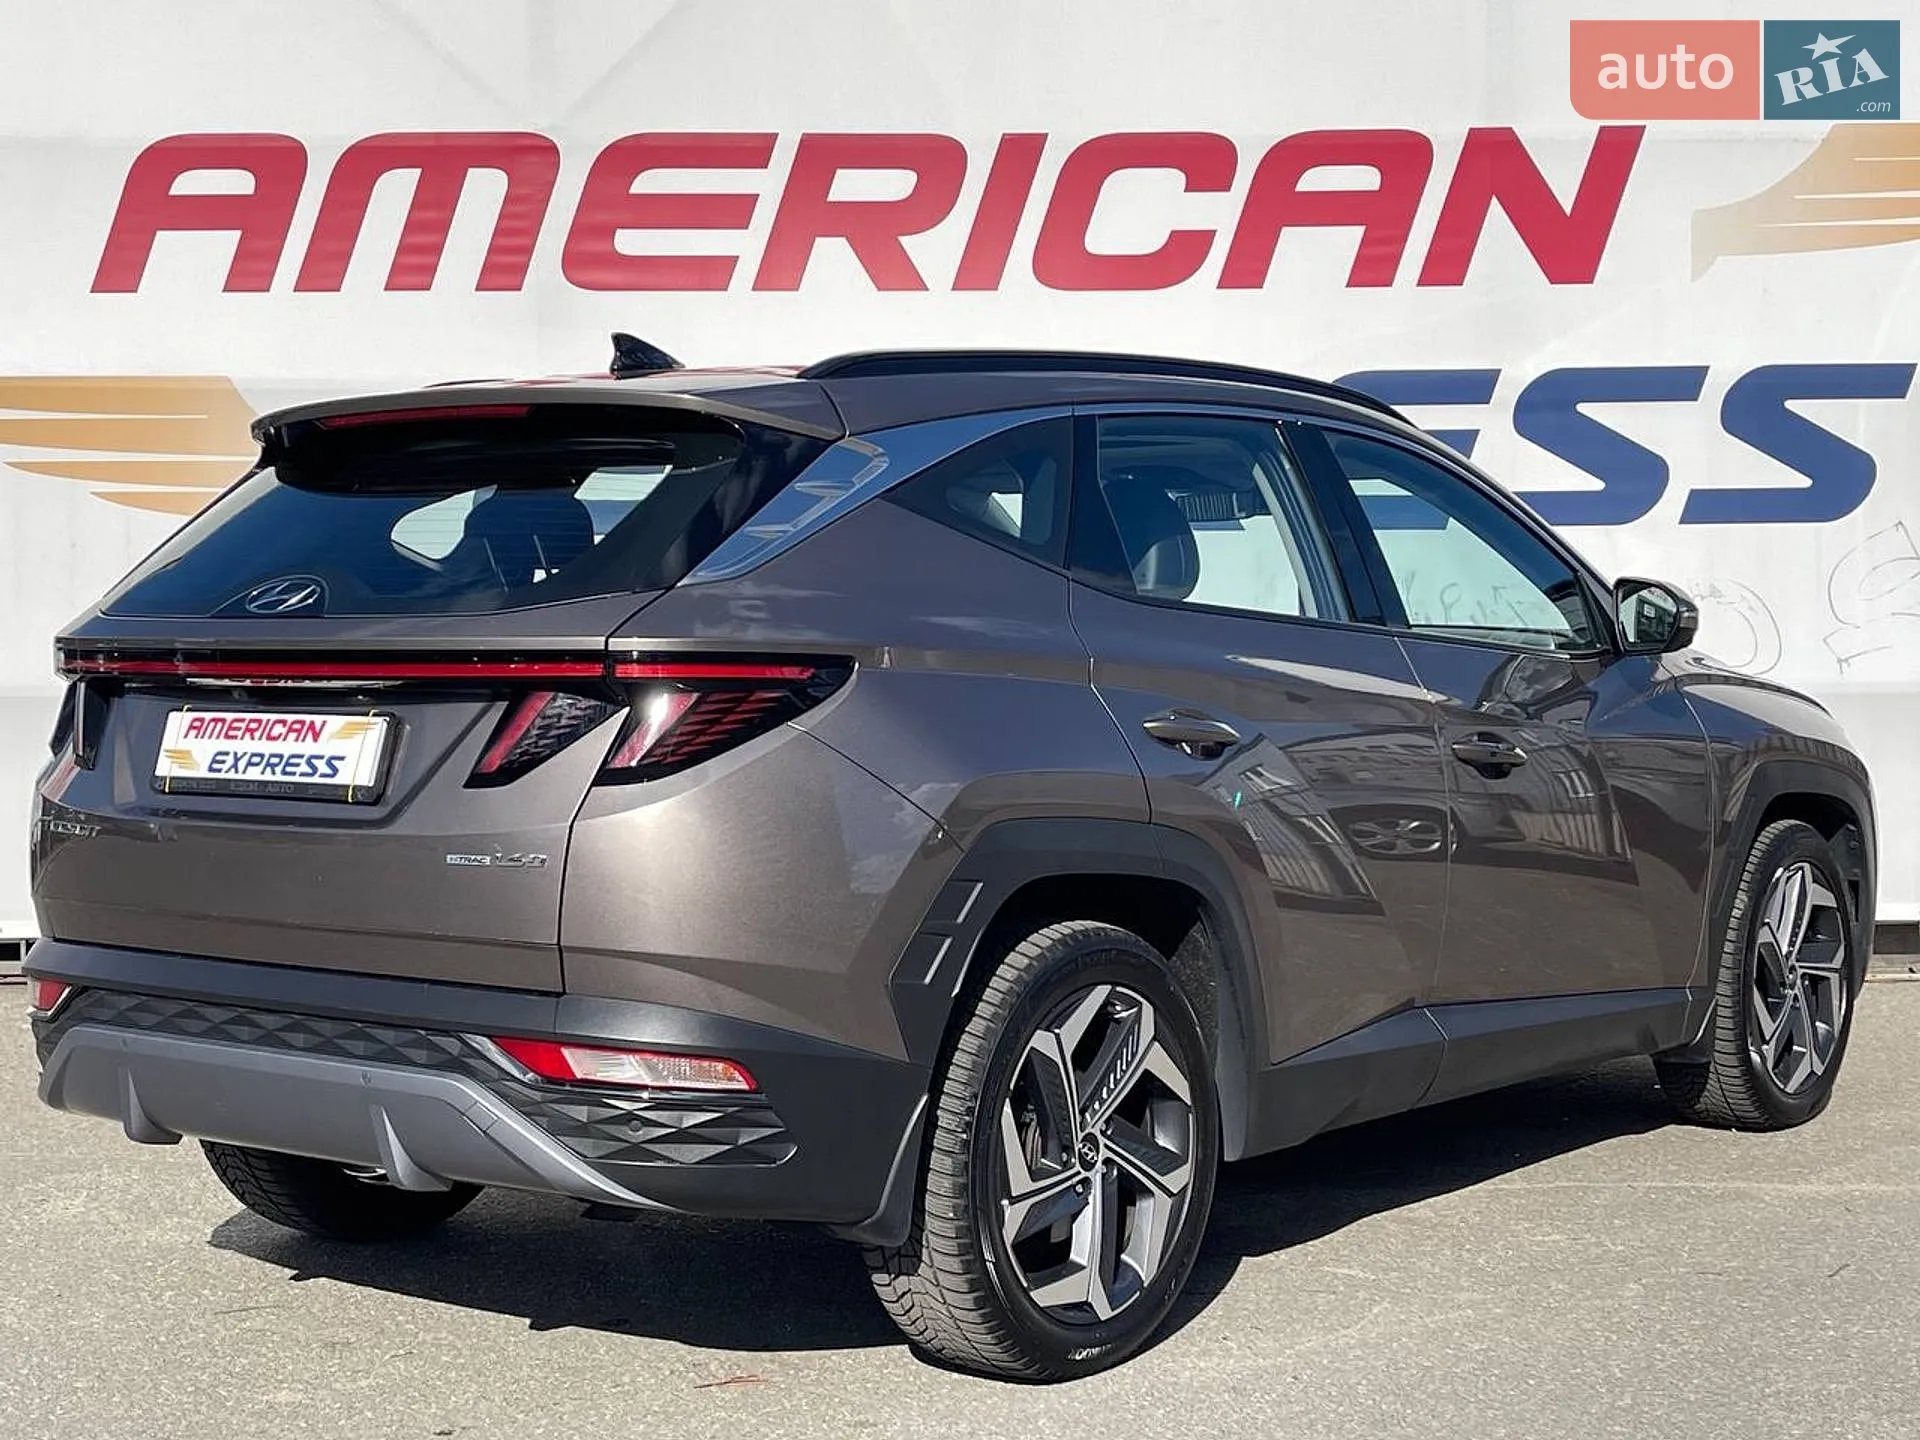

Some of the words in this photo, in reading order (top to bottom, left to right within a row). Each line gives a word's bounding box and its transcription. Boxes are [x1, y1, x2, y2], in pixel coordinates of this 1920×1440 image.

[90, 125, 1646, 293] AMERICAN
[183, 717, 327, 742] AMERICAN
[207, 751, 346, 778] EXPRESS
